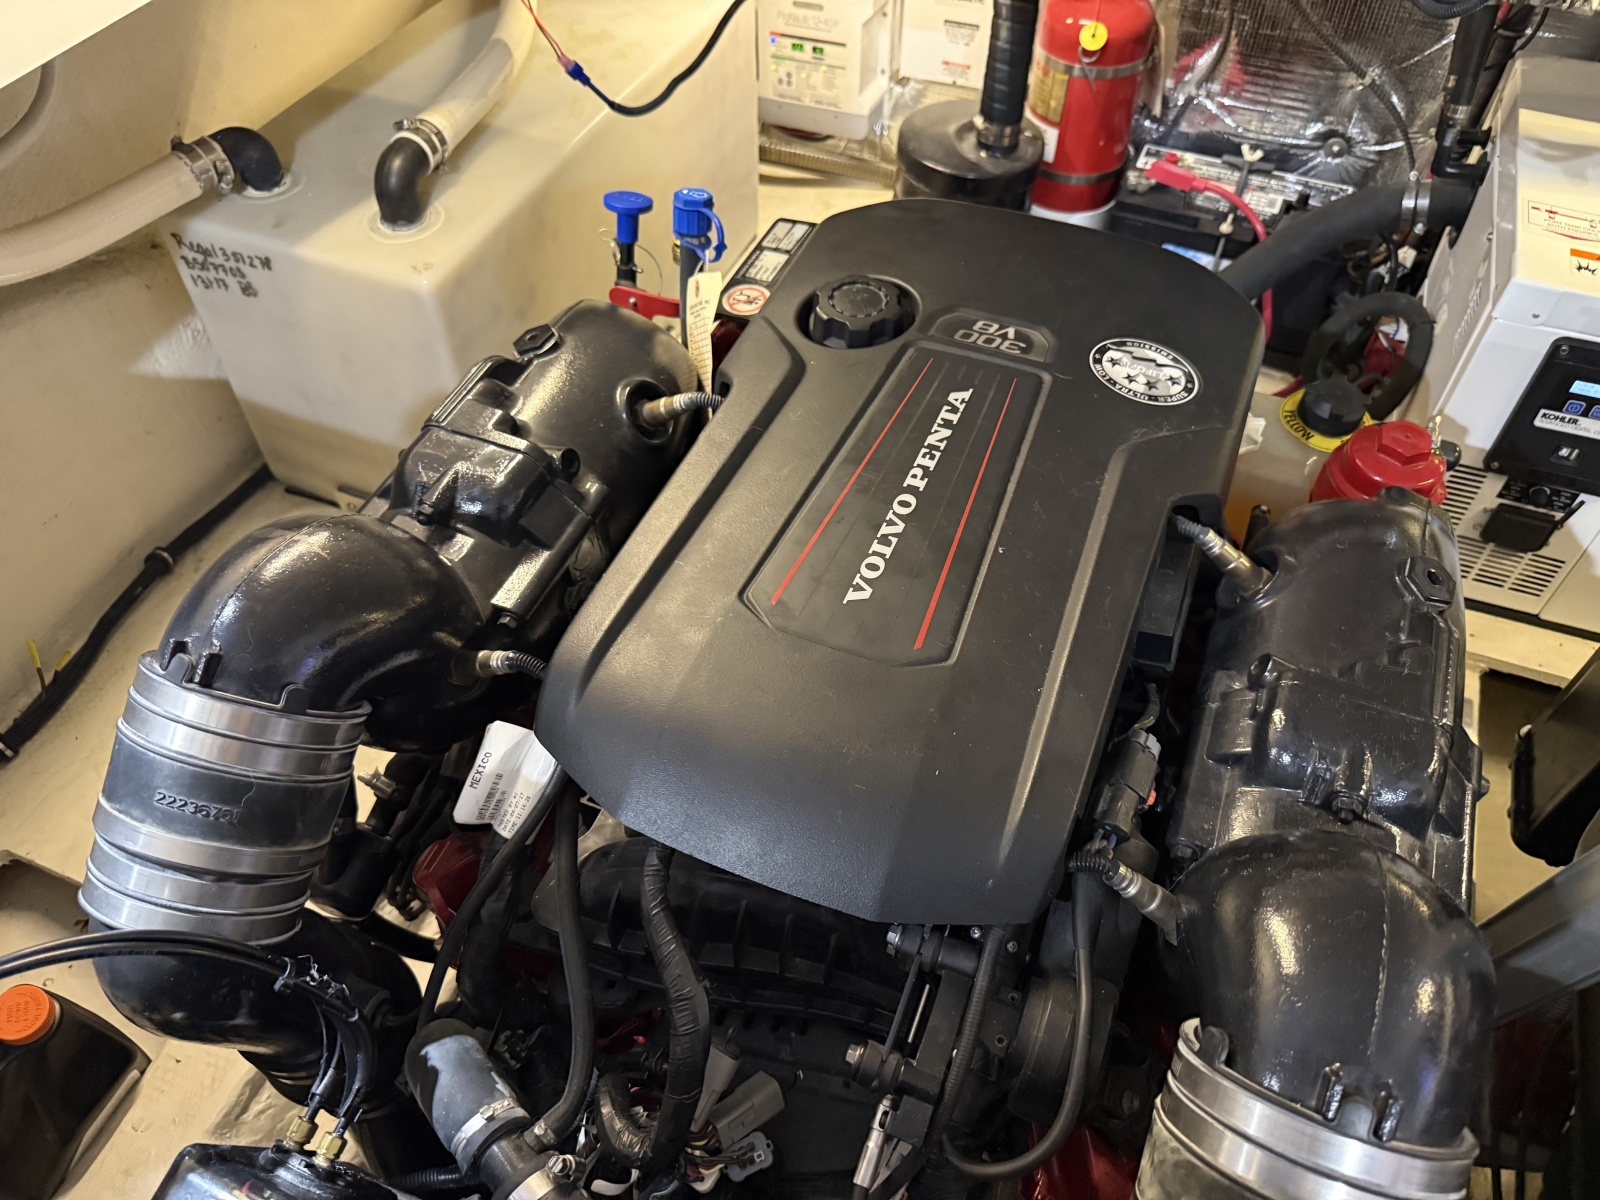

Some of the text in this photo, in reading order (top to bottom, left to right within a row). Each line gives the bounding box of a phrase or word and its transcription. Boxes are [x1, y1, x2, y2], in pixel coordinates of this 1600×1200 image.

[953, 329, 1027, 354] 300
[972, 320, 1017, 340] V8
[1126, 342, 1174, 360] EMISSION
[1094, 364, 1189, 402] SUPER ULTRA LOW
[1283, 410, 1315, 441] YELLOW
[1541, 412, 1579, 426] KOHLER
[842, 388, 974, 604] VOLVO PENTA
[468, 751, 492, 790] MEXICO
